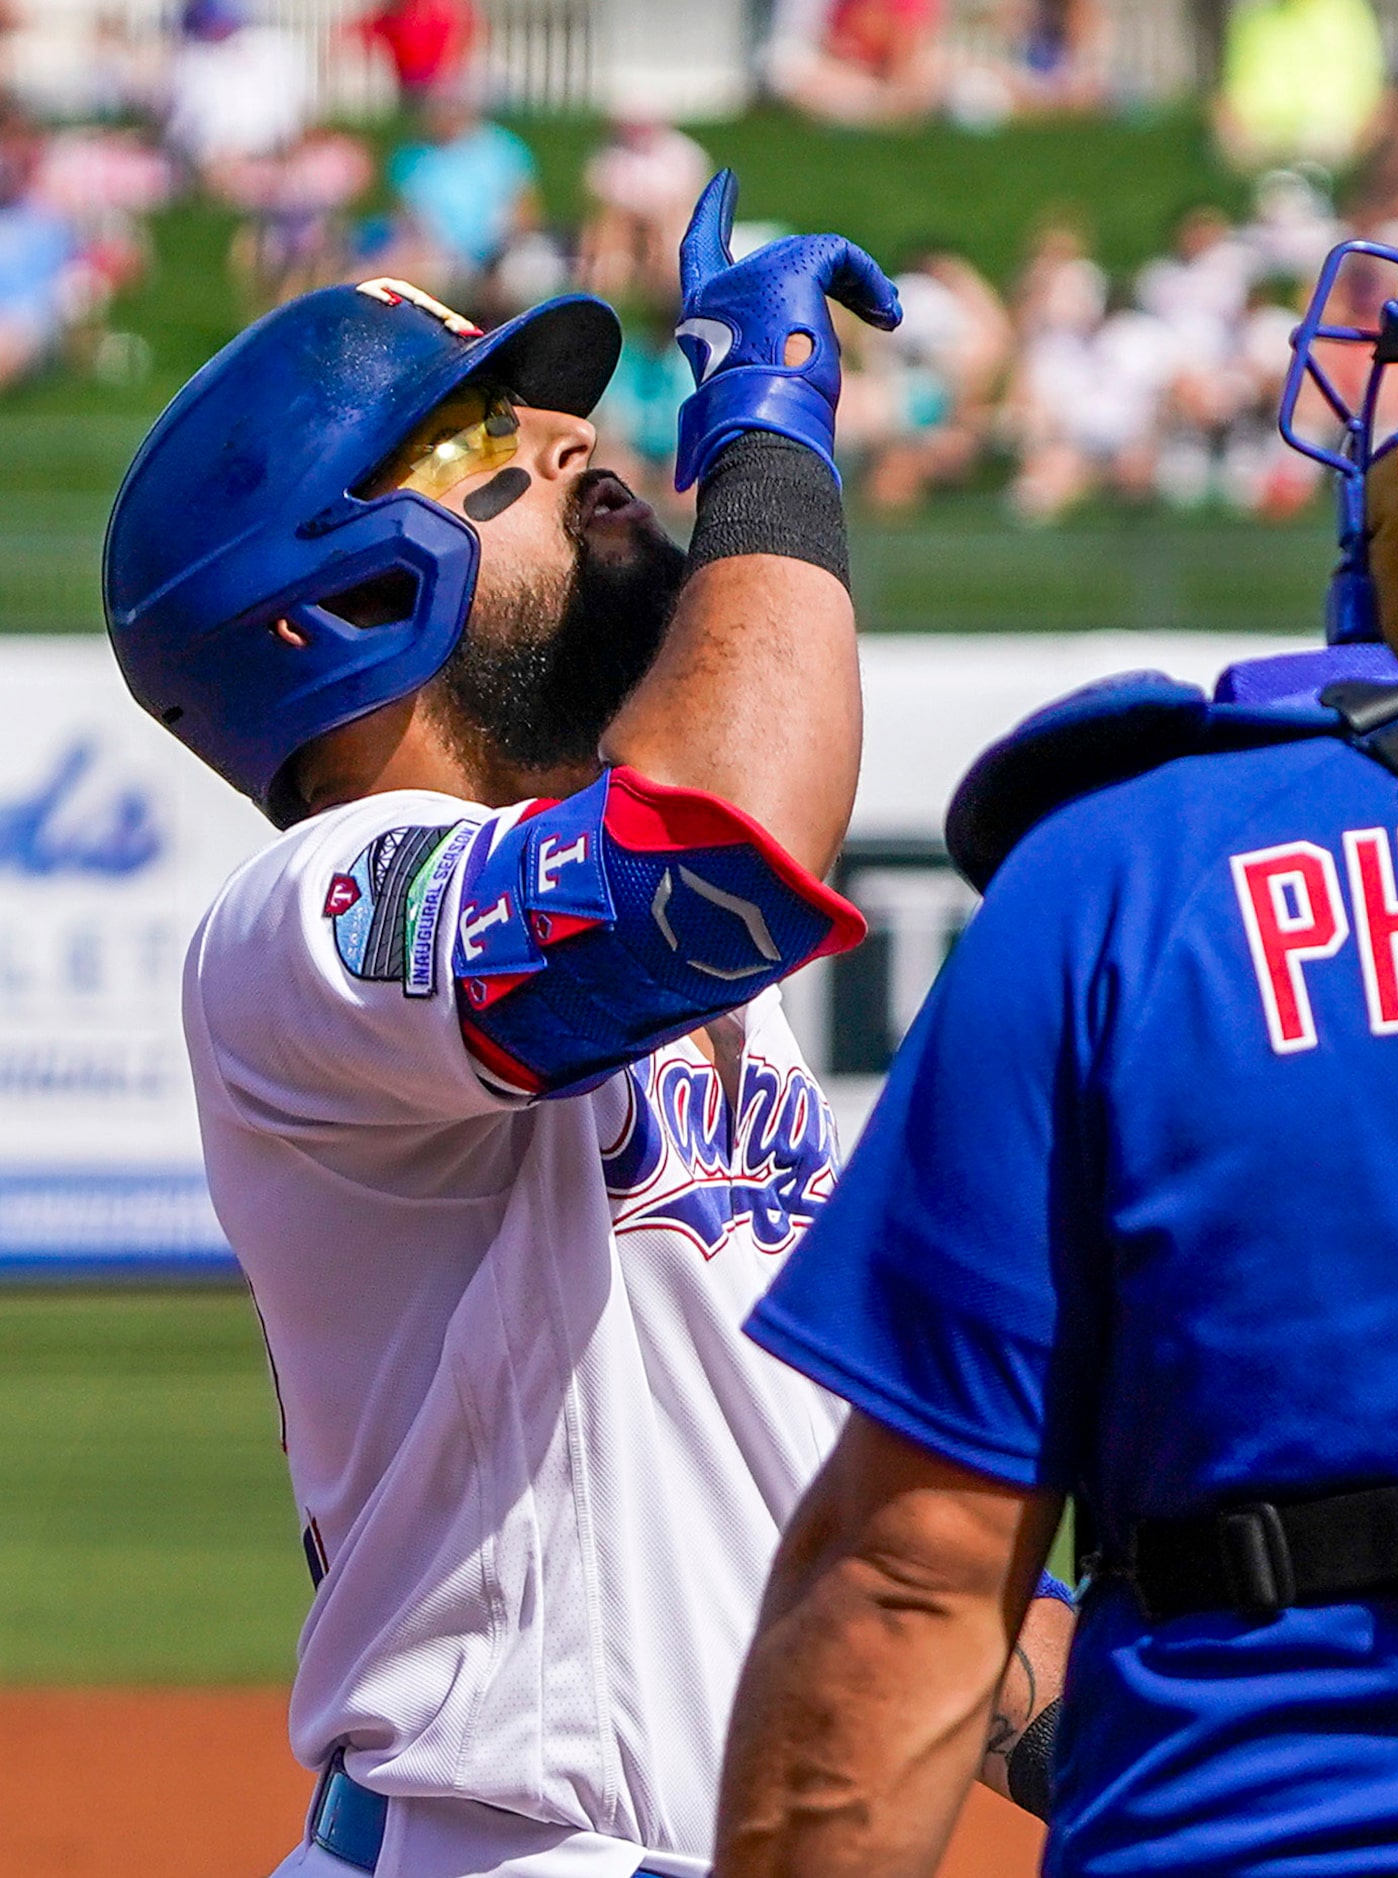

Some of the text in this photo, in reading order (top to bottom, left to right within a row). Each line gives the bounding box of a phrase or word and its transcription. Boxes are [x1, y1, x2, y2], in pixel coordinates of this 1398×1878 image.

[537, 832, 589, 894] T
[412, 827, 476, 986] INAUGURAL SEASON
[459, 891, 513, 962] T
